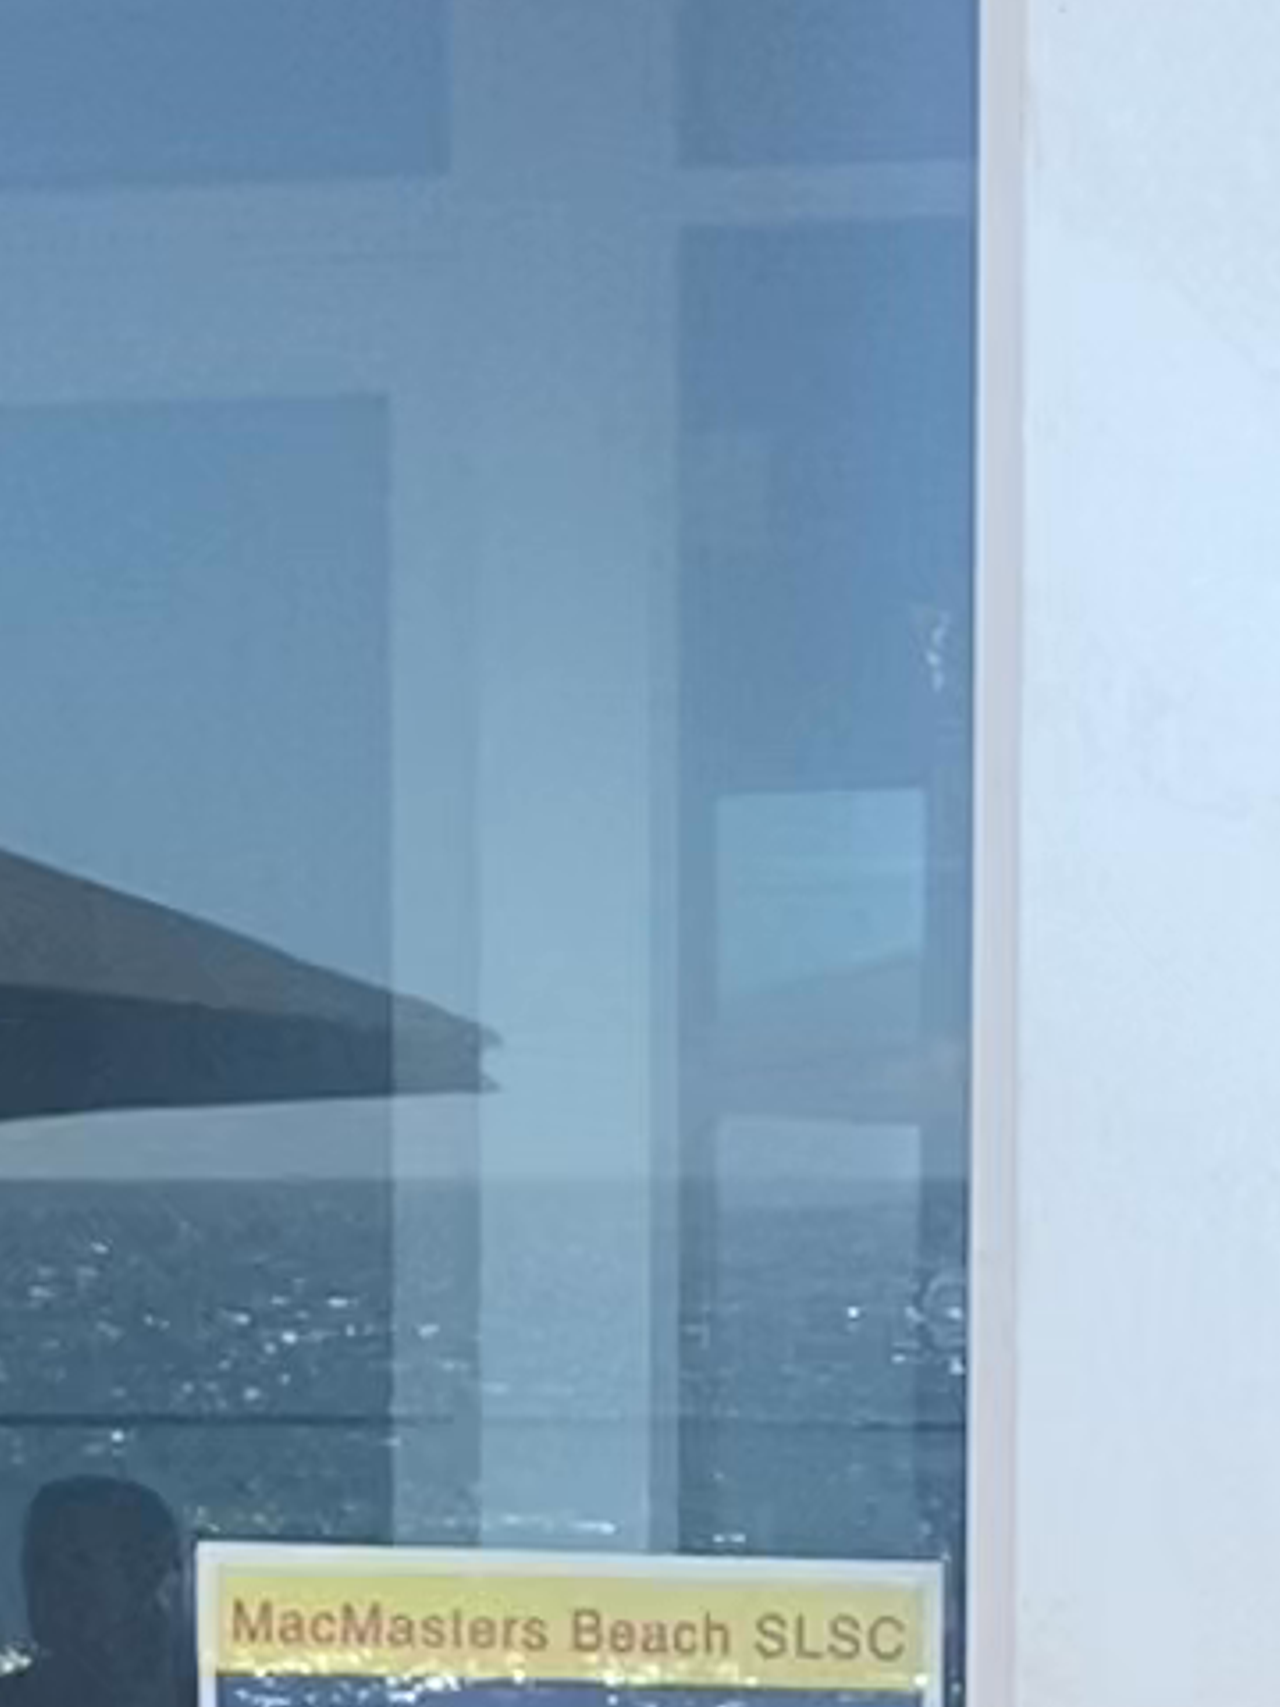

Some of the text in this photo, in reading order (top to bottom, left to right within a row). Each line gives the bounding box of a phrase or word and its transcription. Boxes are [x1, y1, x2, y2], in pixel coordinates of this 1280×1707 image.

[232, 1598, 906, 1661] MacMasters Beach SLSC
